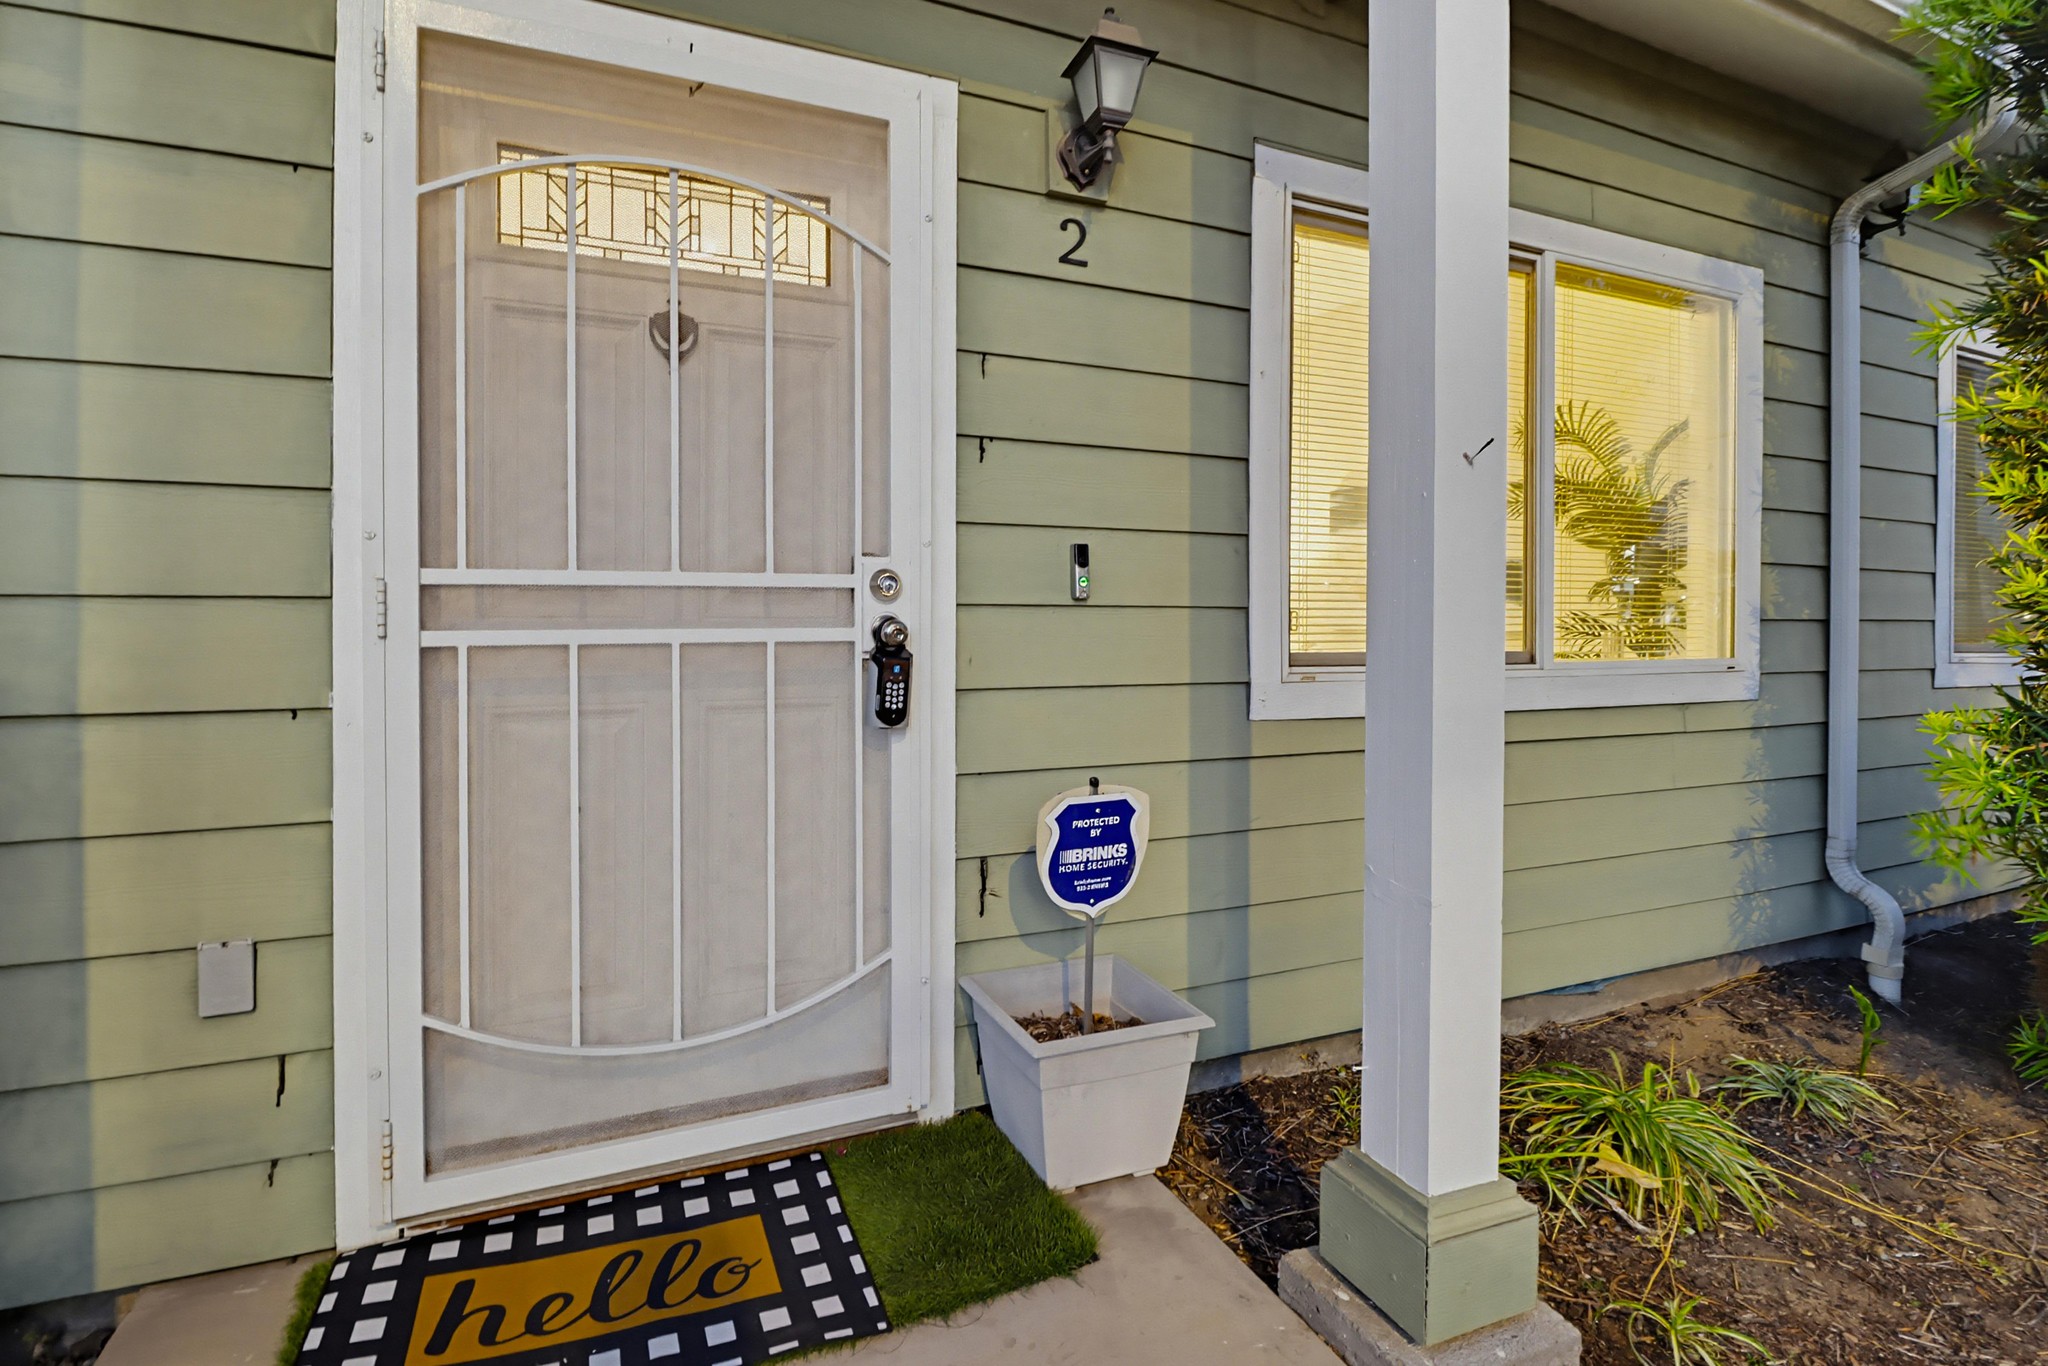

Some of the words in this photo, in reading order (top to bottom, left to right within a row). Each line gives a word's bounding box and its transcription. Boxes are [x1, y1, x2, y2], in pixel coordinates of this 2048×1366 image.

[1058, 217, 1088, 268] 2
[1072, 816, 1120, 829] PROTECTED
[1090, 828, 1102, 837] BY
[1071, 843, 1128, 864] BRINKS
[1059, 863, 1085, 873] HOME
[424, 1238, 762, 1356] hello
